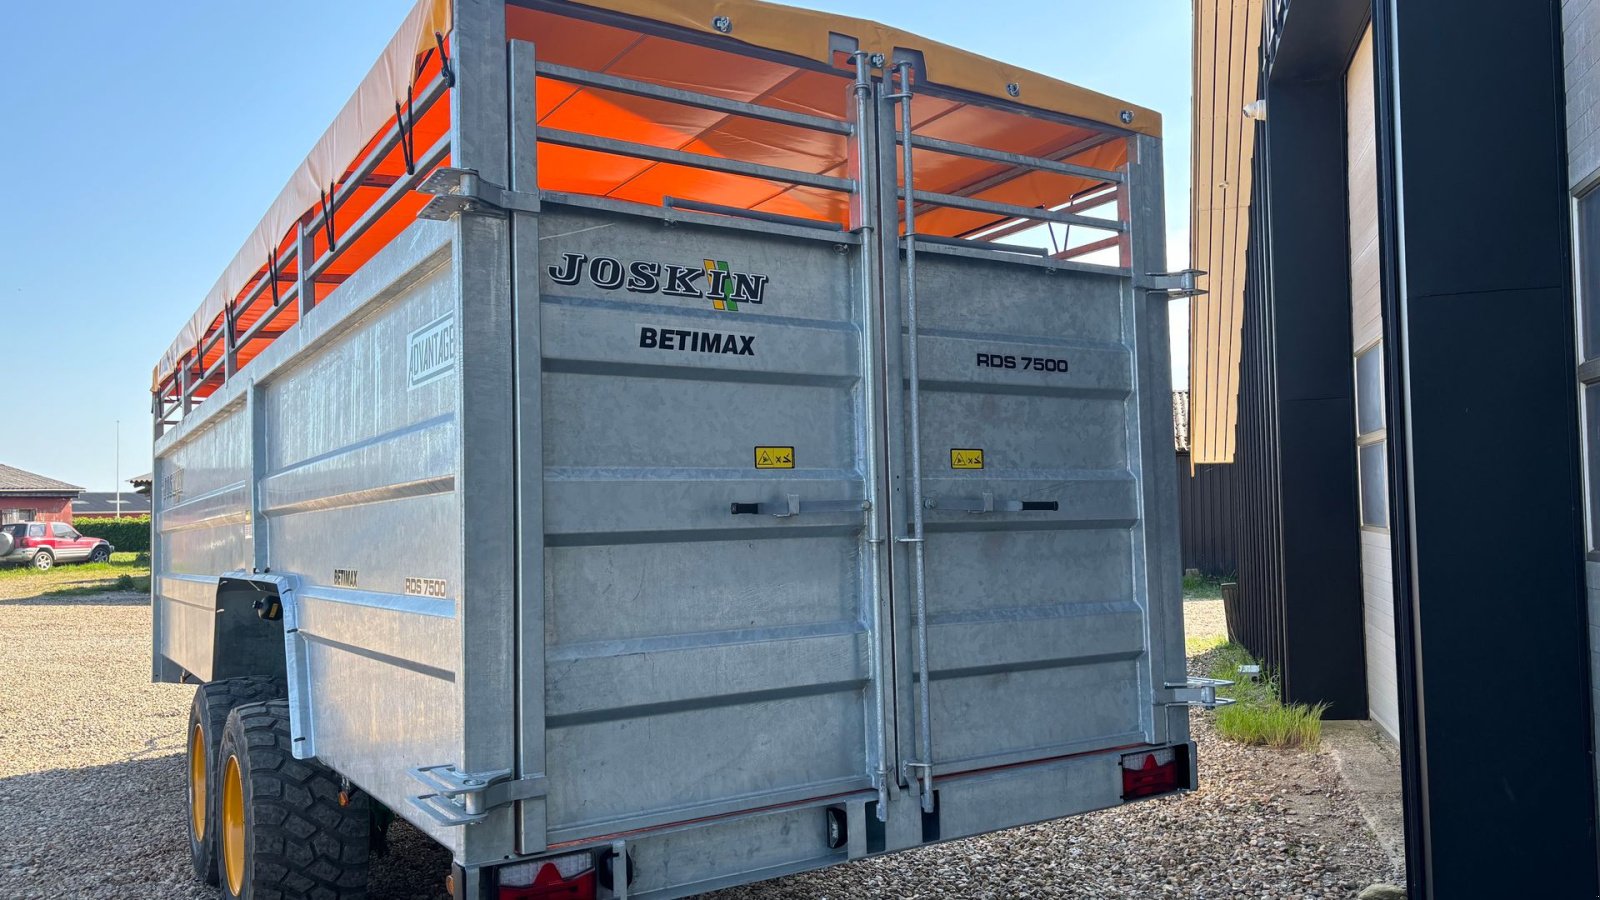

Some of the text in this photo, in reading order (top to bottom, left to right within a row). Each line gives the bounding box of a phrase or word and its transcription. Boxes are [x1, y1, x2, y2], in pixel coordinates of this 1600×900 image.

[547, 252, 768, 304] JOSKIN
[639, 327, 755, 356] BETIMAX
[408, 325, 454, 390] ADVANTAGE
[976, 353, 1068, 373] RDS 7500
[333, 569, 358, 588] BETIMAX
[405, 578, 446, 597] RDS 7500
